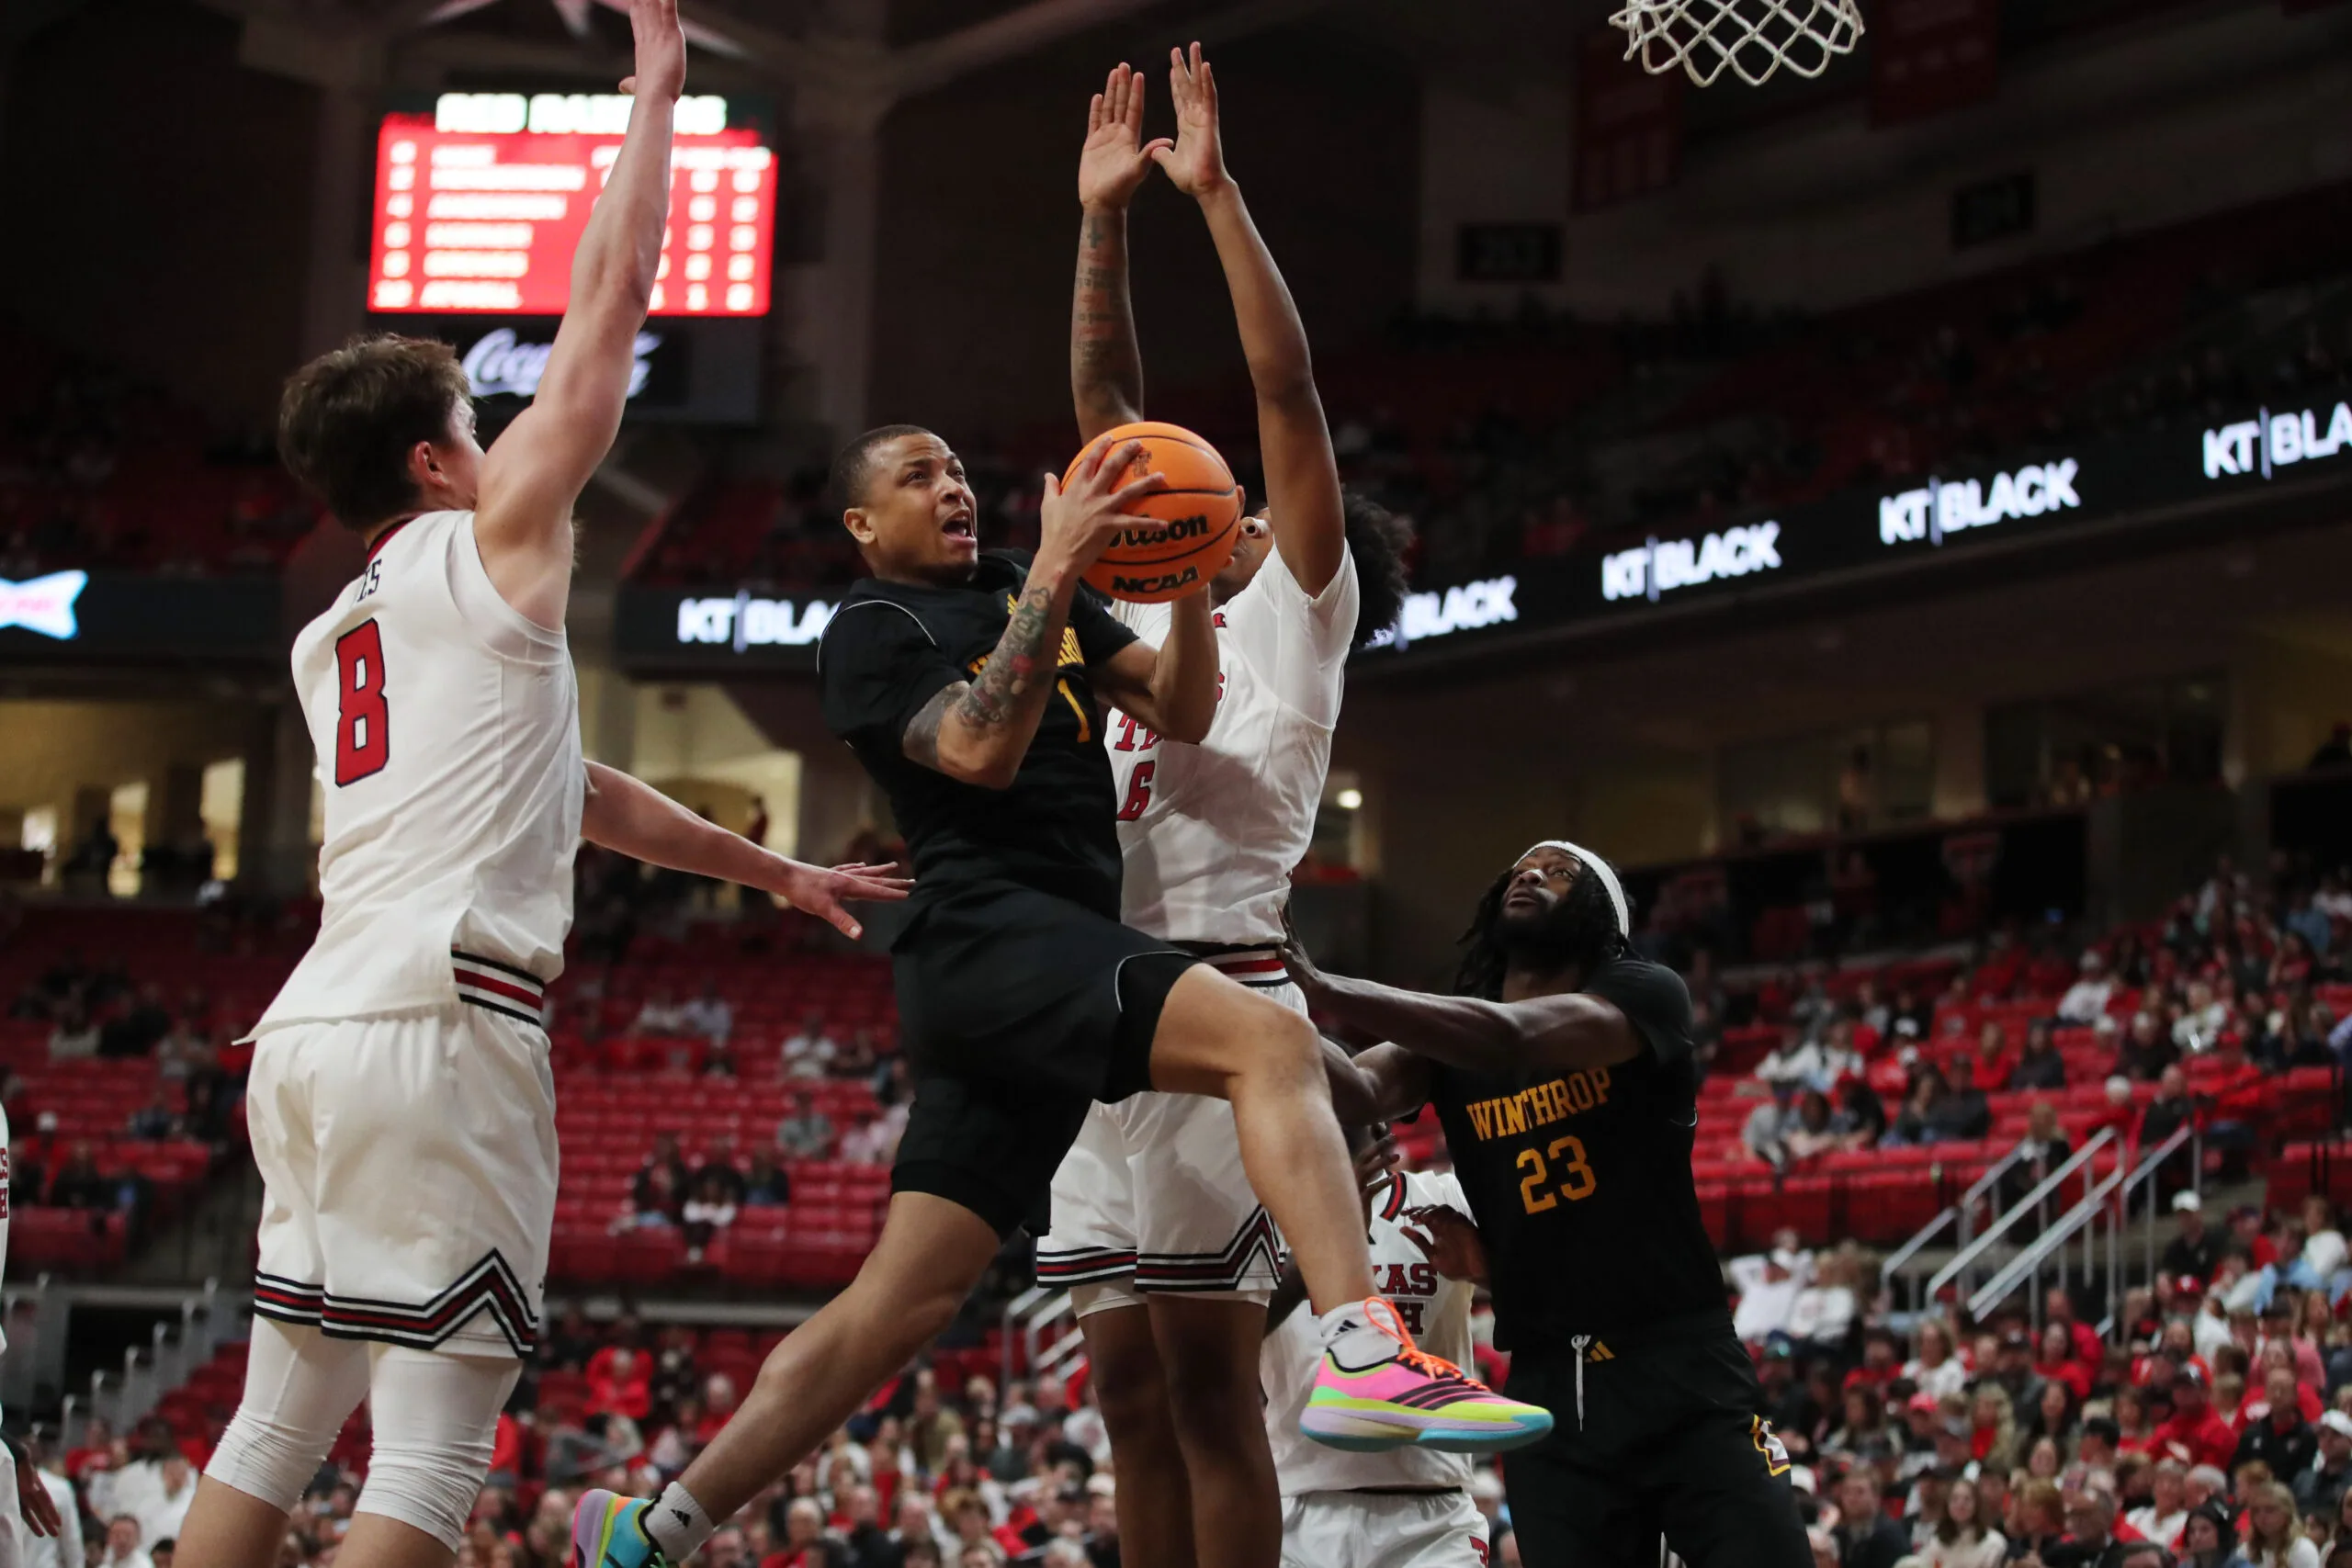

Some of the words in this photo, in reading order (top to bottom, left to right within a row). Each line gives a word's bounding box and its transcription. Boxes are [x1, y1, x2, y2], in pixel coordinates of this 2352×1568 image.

[1936, 457, 2080, 533] BLACK
[1112, 565, 1199, 593] NCAA
[1654, 520, 1782, 591] BLACK
[1401, 574, 1519, 640] BLACK
[334, 616, 390, 788] 8
[1057, 677, 1091, 743] 1
[1116, 760, 1156, 821] 6
[1465, 1066, 1611, 1142] WINTHROP
[1516, 1134, 1597, 1215] 23
